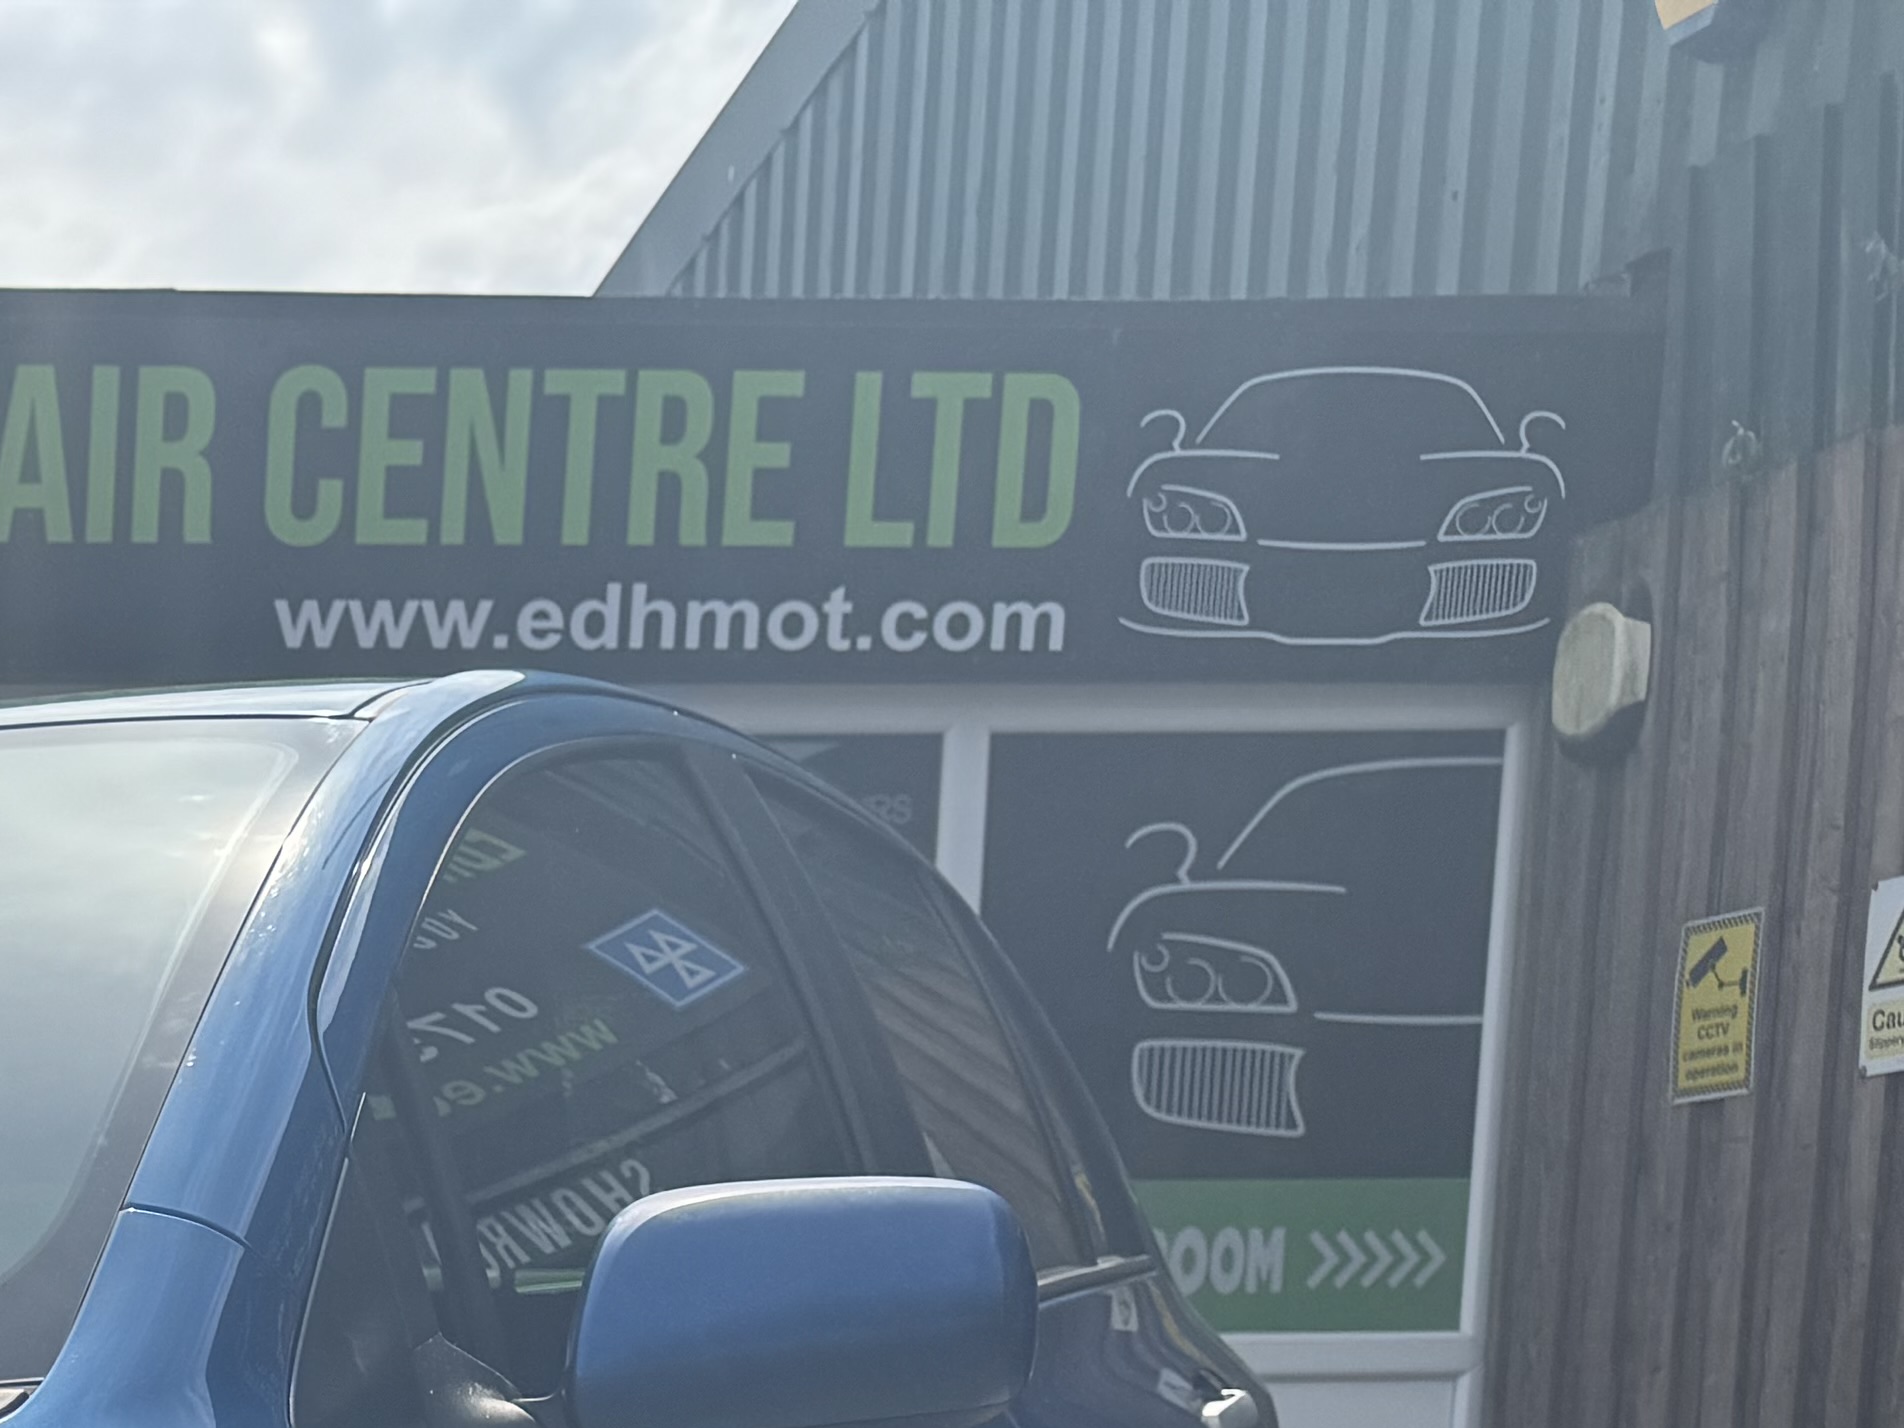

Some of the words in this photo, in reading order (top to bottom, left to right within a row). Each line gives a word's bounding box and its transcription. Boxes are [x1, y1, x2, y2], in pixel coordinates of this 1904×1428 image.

[265, 365, 804, 547] CENTRE
[844, 371, 1082, 549] LTD
[275, 583, 1066, 653] www.edhmot.com
[1697, 1022, 1730, 1040] CCTV
[1153, 1225, 1286, 1297] OOM
